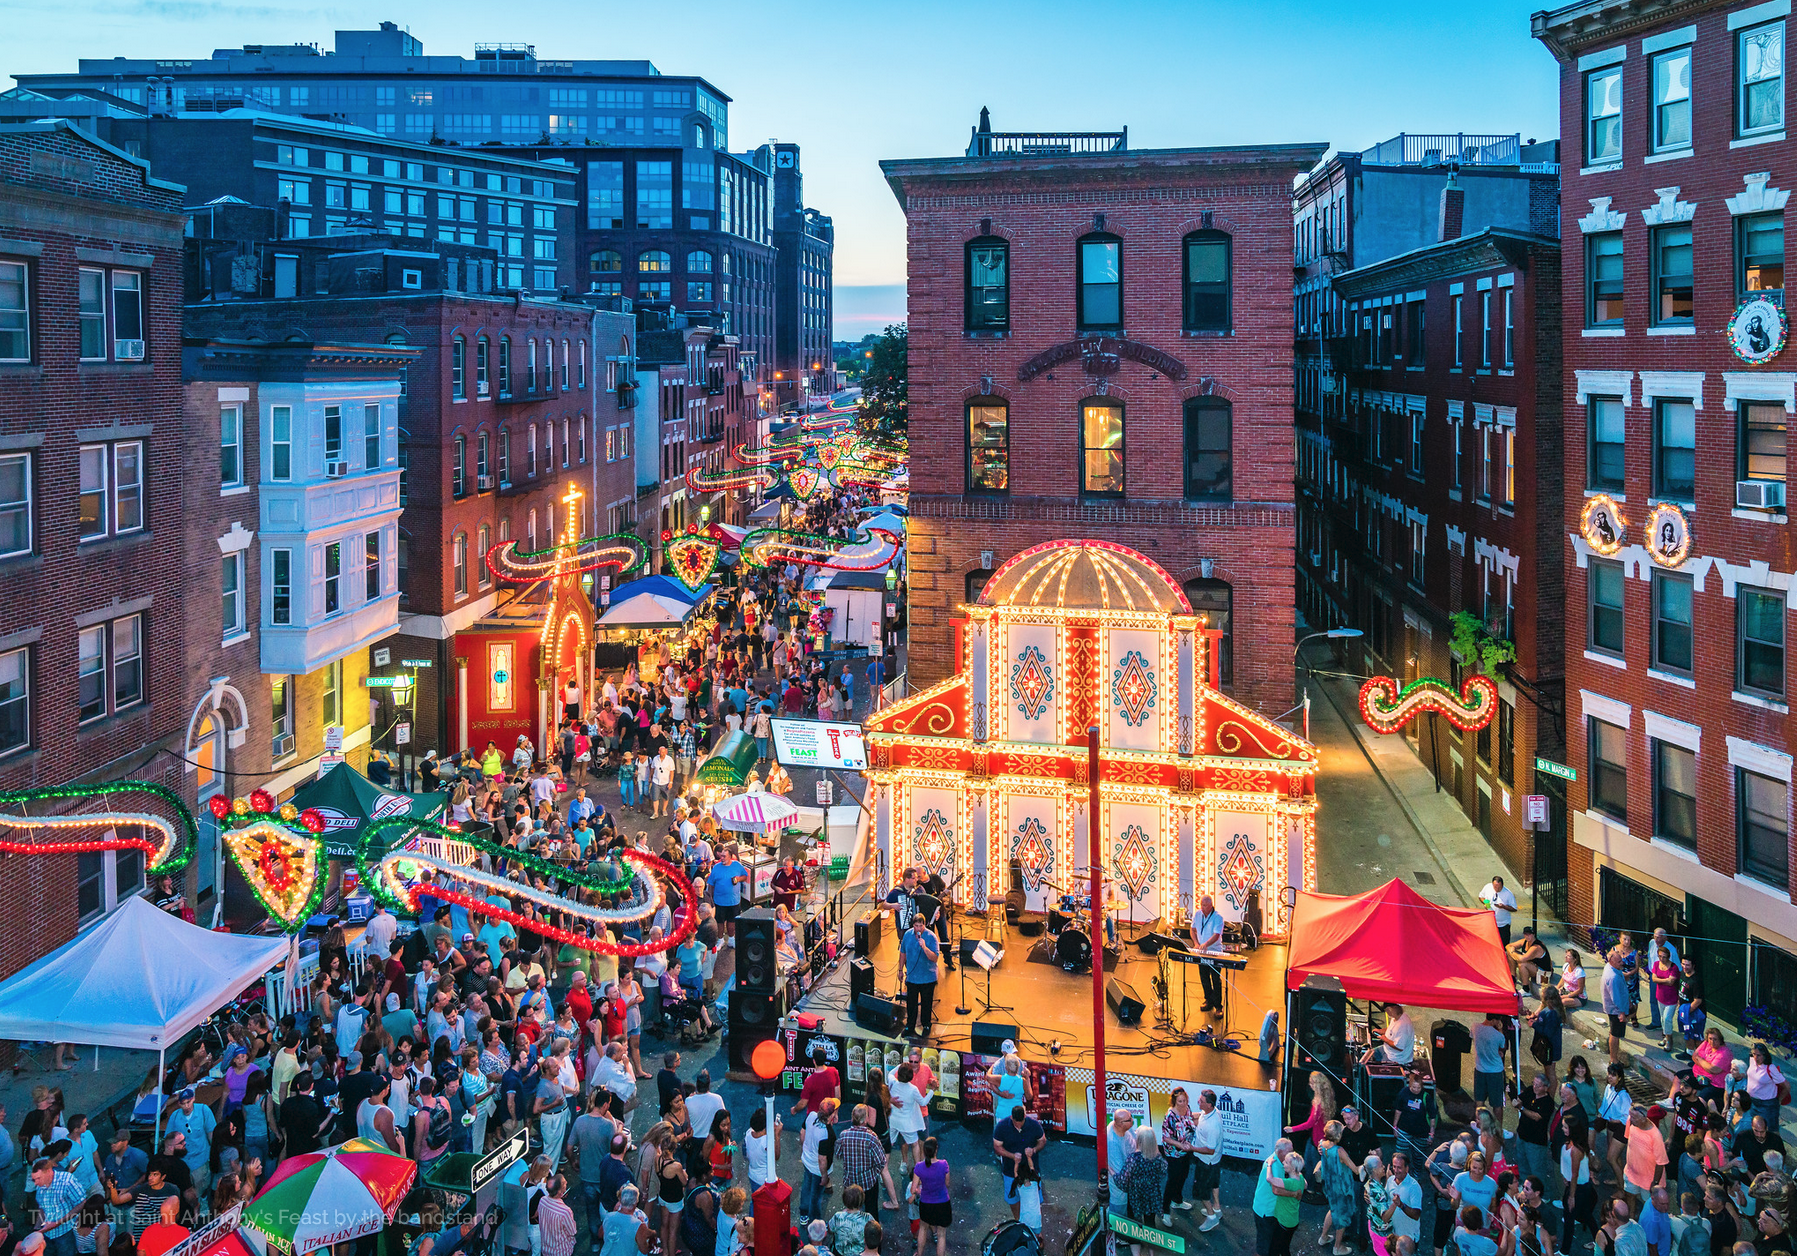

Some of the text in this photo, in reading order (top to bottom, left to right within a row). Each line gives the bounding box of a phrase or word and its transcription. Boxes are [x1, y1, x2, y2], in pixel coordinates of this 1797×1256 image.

[374, 678, 396, 686] ENDICOT
[440, 756, 452, 764] POLICE
[790, 748, 818, 757] FEAST
[1551, 763, 1570, 778] MARGIN
[1222, 1120, 1249, 1129] ETPLACE
[1233, 1113, 1249, 1123] Hall
[1226, 1128, 1251, 1136] Experience
[478, 1147, 513, 1179] ONE WAY
[407, 1169, 416, 1190] ICE
[173, 1238, 190, 1255] ICE
[191, 1217, 221, 1242] COLD
[200, 1217, 234, 1250] SLUSH
[303, 1219, 379, 1252] ITALIAN ICE
[1115, 1220, 1176, 1249] NO MARGIN ST
[277, 1236, 291, 1252] ICE
